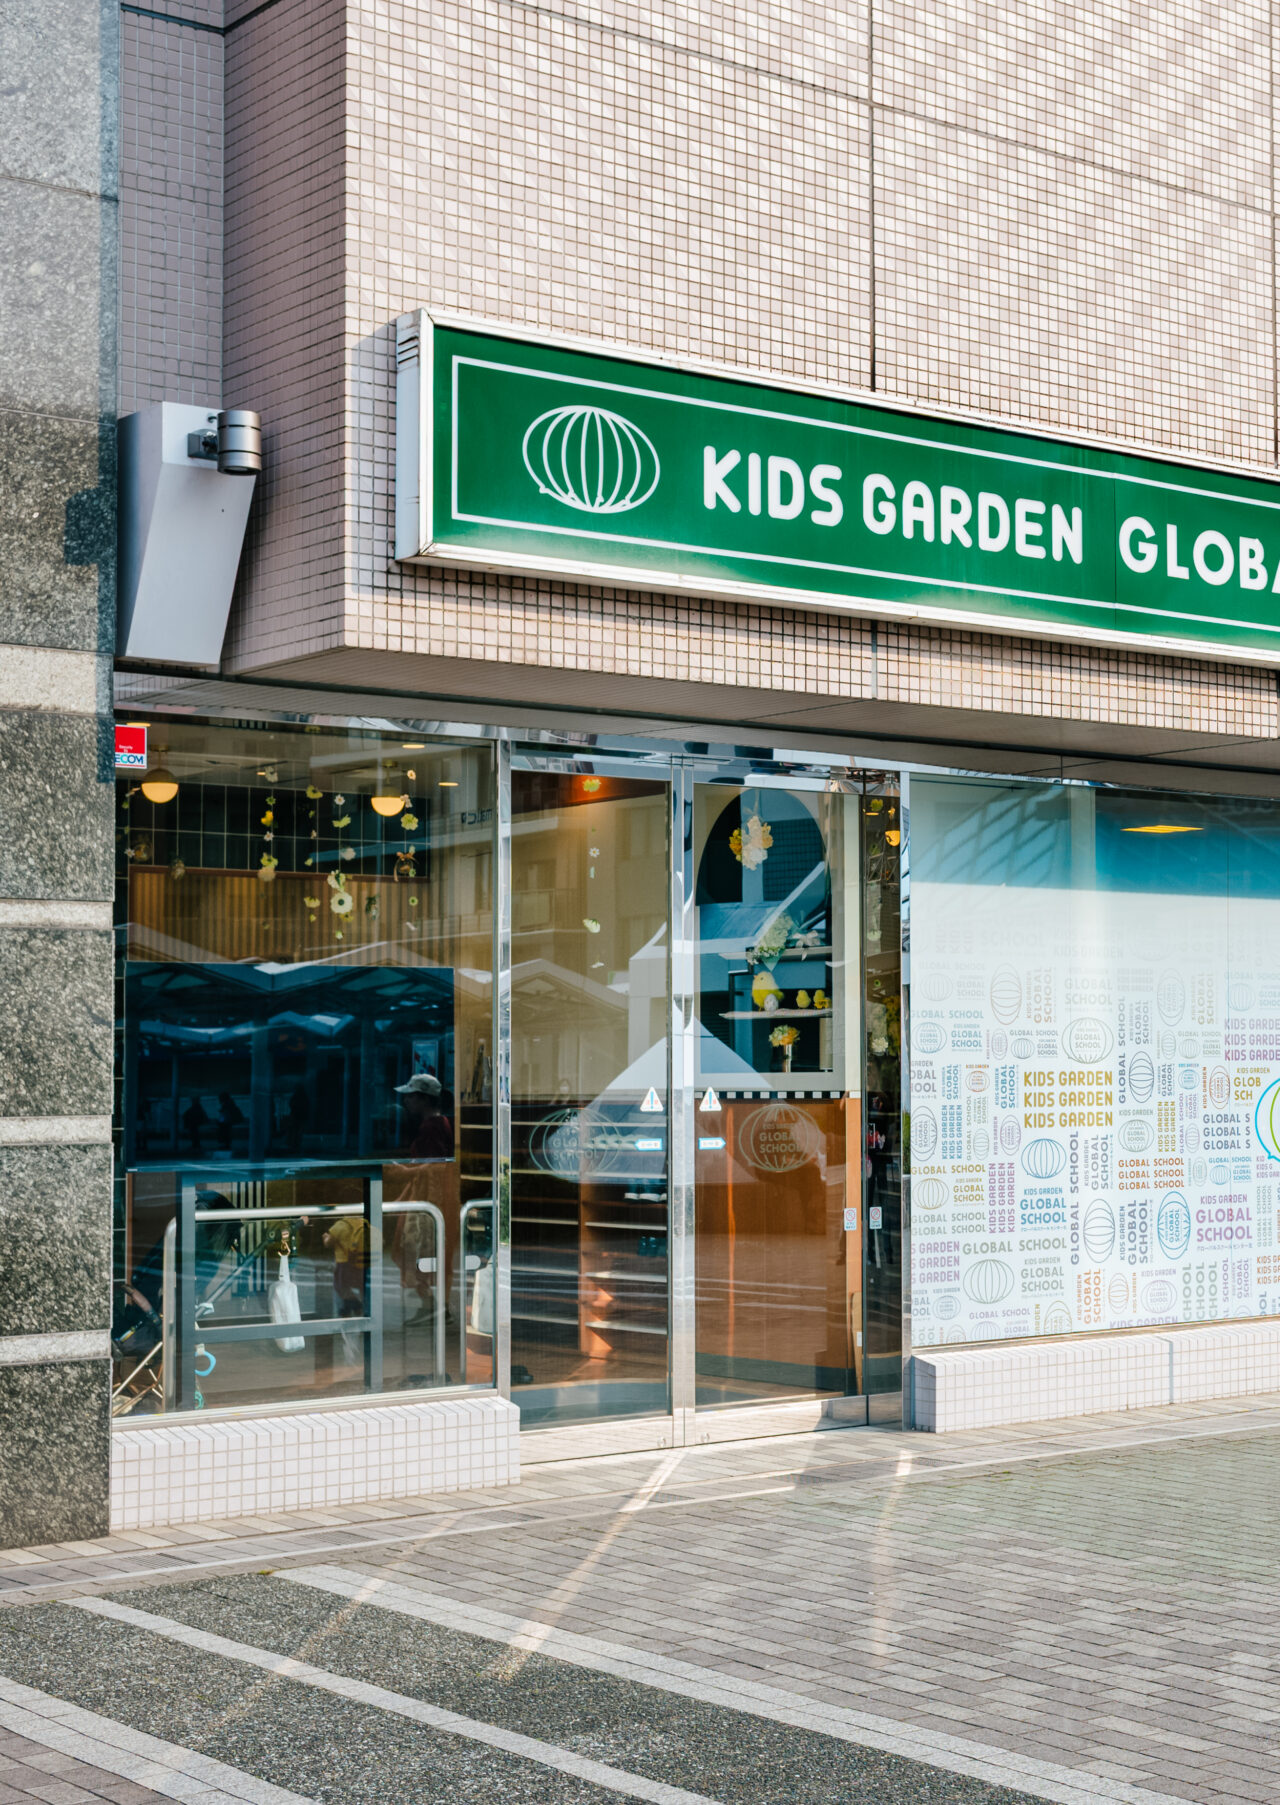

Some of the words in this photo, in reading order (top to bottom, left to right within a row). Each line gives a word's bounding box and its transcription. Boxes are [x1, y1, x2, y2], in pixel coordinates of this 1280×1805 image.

[703, 445, 844, 527] KIDS
[862, 473, 1084, 565] GARDEN
[115, 754, 144, 764] ECOM
[1064, 978, 1113, 990] GLOBAL
[1065, 994, 1113, 1005] SCHOOL
[1224, 1018, 1246, 1030] KIDS
[1224, 1034, 1246, 1046] KIDS
[1224, 1049, 1246, 1061] KIDS
[1024, 1071, 1055, 1086] KIDS
[1059, 1071, 1113, 1086] GARDEN
[1234, 1077, 1260, 1087] GLOB
[1024, 1092, 1055, 1108] KIDS
[1059, 1091, 1113, 1107] GARDEN
[1234, 1090, 1252, 1100] SCH
[1024, 1113, 1055, 1128] KIDS
[1059, 1111, 1113, 1127] GARDEN
[1203, 1114, 1240, 1124] GLOBAL
[1245, 1113, 1250, 1122] S
[1203, 1127, 1240, 1137] GLOBAL
[1245, 1126, 1250, 1136] S
[760, 1144, 800, 1153] SCHOOL
[1203, 1140, 1240, 1150] GLOBAL
[1245, 1140, 1250, 1149] S
[1070, 1130, 1079, 1194] SCHOOL
[1091, 1134, 1099, 1190] GLOBAL
[1101, 1134, 1109, 1190] SCHOOL
[1118, 1159, 1150, 1168] GLOBAL
[1154, 1158, 1184, 1166] SCHOOL
[1118, 1171, 1150, 1179] GLOBAL
[1154, 1169, 1184, 1178] SCHOOL
[954, 1185, 984, 1193] GLOBAL
[1007, 1163, 1015, 1206] GARDEN
[1118, 1182, 1150, 1190] GLOBAL
[1154, 1180, 1184, 1189] SCHOOL
[954, 1194, 984, 1202] SCHOOL
[1020, 1198, 1067, 1210] GLOBAL
[1200, 1196, 1217, 1205] KIDS
[1218, 1194, 1248, 1203] GARDEN
[1021, 1212, 1067, 1225] SCHOOL
[1196, 1207, 1252, 1223] GLOBAL
[1070, 1202, 1079, 1265] GLOBAL
[1128, 1200, 1136, 1265] GLOBAL
[1139, 1199, 1148, 1264] SCHOOL
[1197, 1226, 1252, 1242] SCHOOL
[962, 1241, 1013, 1255] GLOBAL
[1019, 1238, 1067, 1251] SCHOOL
[1257, 1256, 1271, 1264] KIDS
[1021, 1266, 1064, 1279] GLOBAL
[1257, 1266, 1271, 1274] KIDS
[1257, 1276, 1271, 1284] KIDS
[1021, 1280, 1064, 1293] SCHOOL
[969, 1312, 998, 1320] GLOBAL
[1002, 1308, 1030, 1317] SCHOOL
